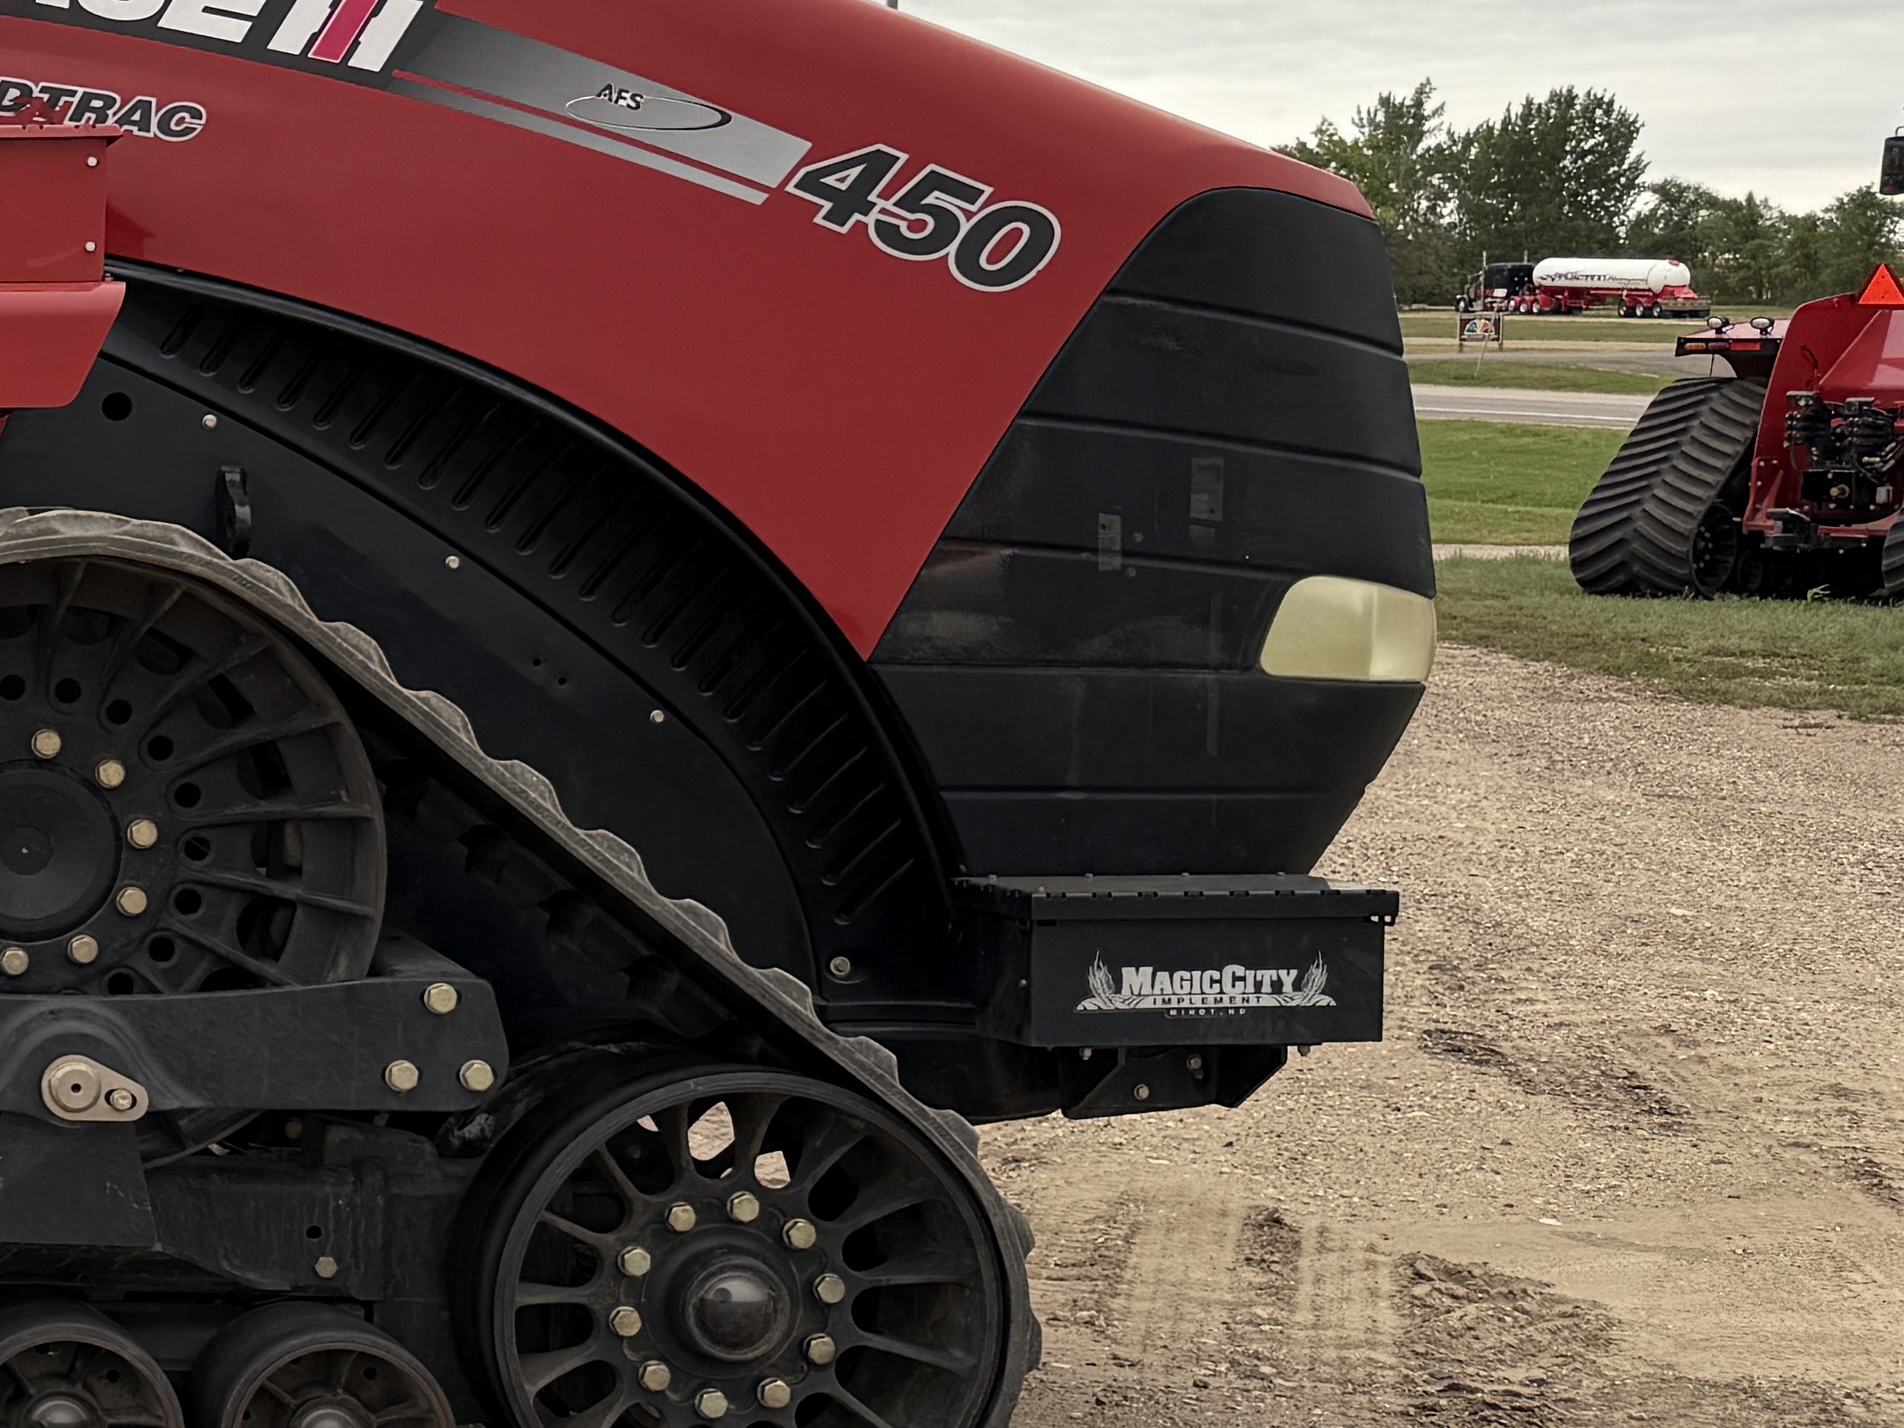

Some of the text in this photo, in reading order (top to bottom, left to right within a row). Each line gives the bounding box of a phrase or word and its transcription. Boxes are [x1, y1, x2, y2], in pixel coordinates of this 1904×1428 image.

[595, 83, 645, 110] AFS
[784, 143, 1062, 293] 450
[1152, 995, 1264, 1006] IMPLEMENT
